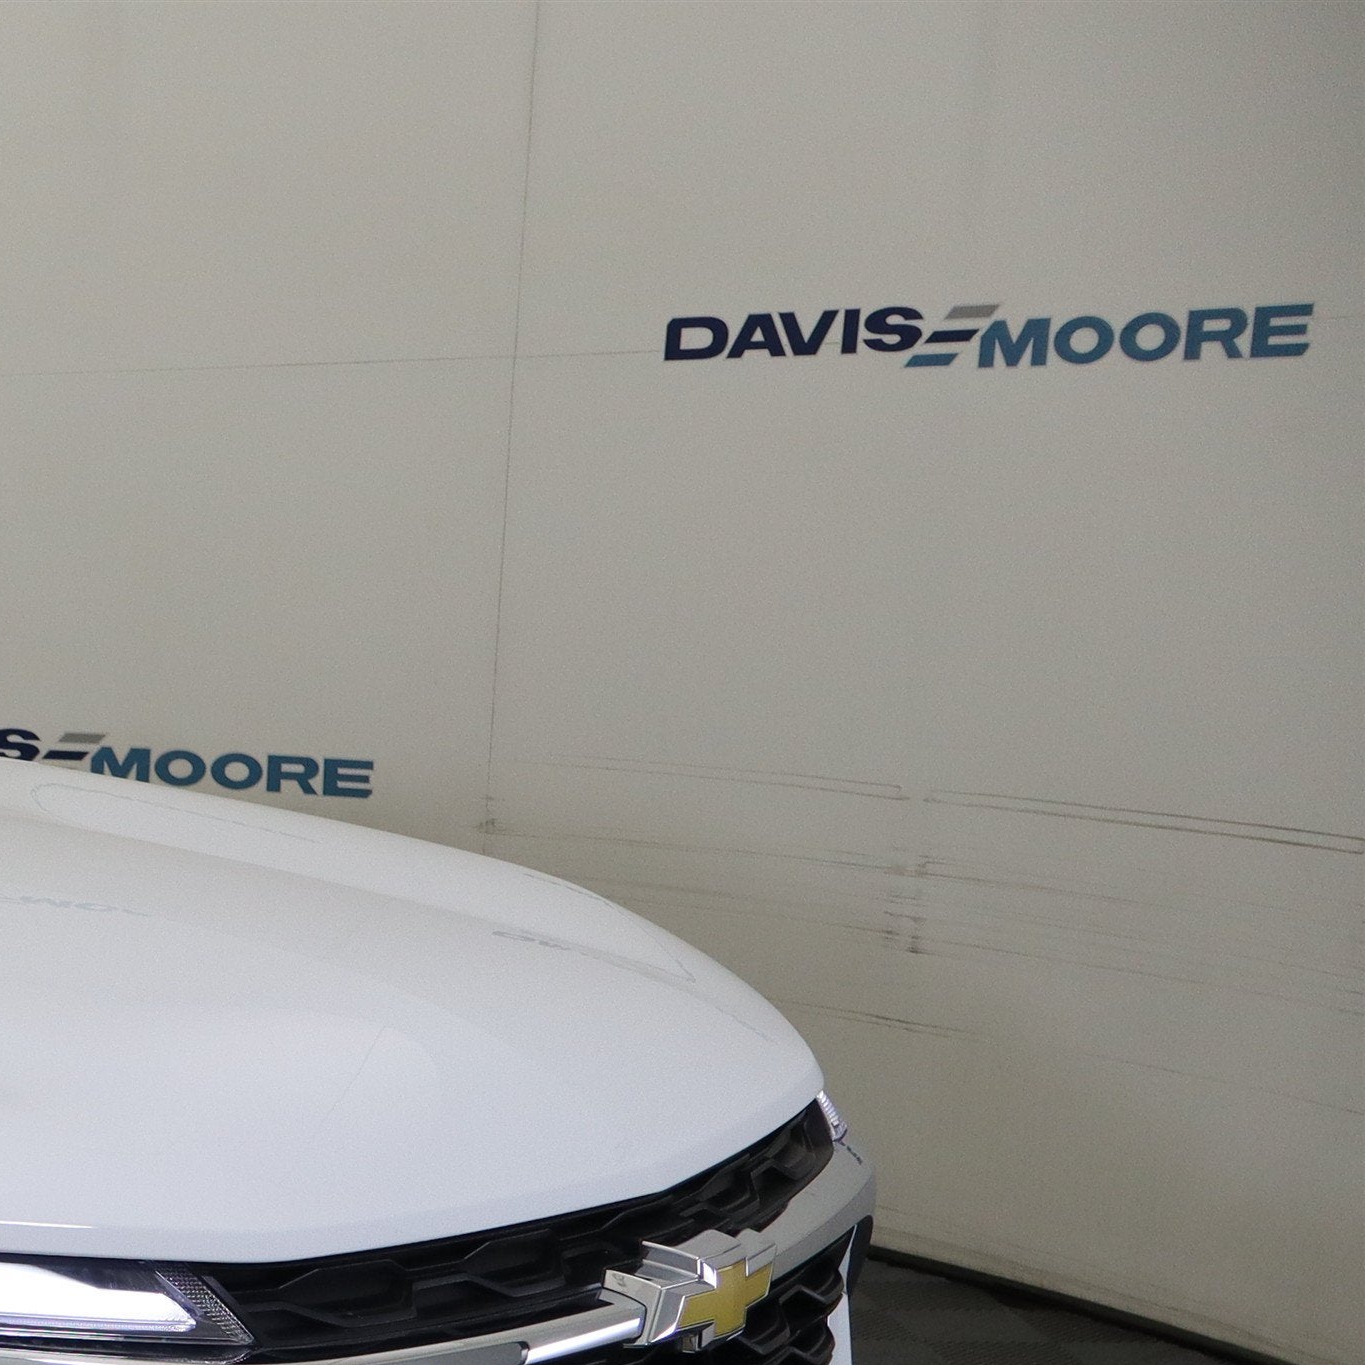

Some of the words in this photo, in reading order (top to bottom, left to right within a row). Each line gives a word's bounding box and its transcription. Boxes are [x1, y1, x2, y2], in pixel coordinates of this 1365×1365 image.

[663, 306, 926, 361] DAVIS
[977, 302, 1314, 369] MOORE
[89, 746, 375, 799] MOORE
